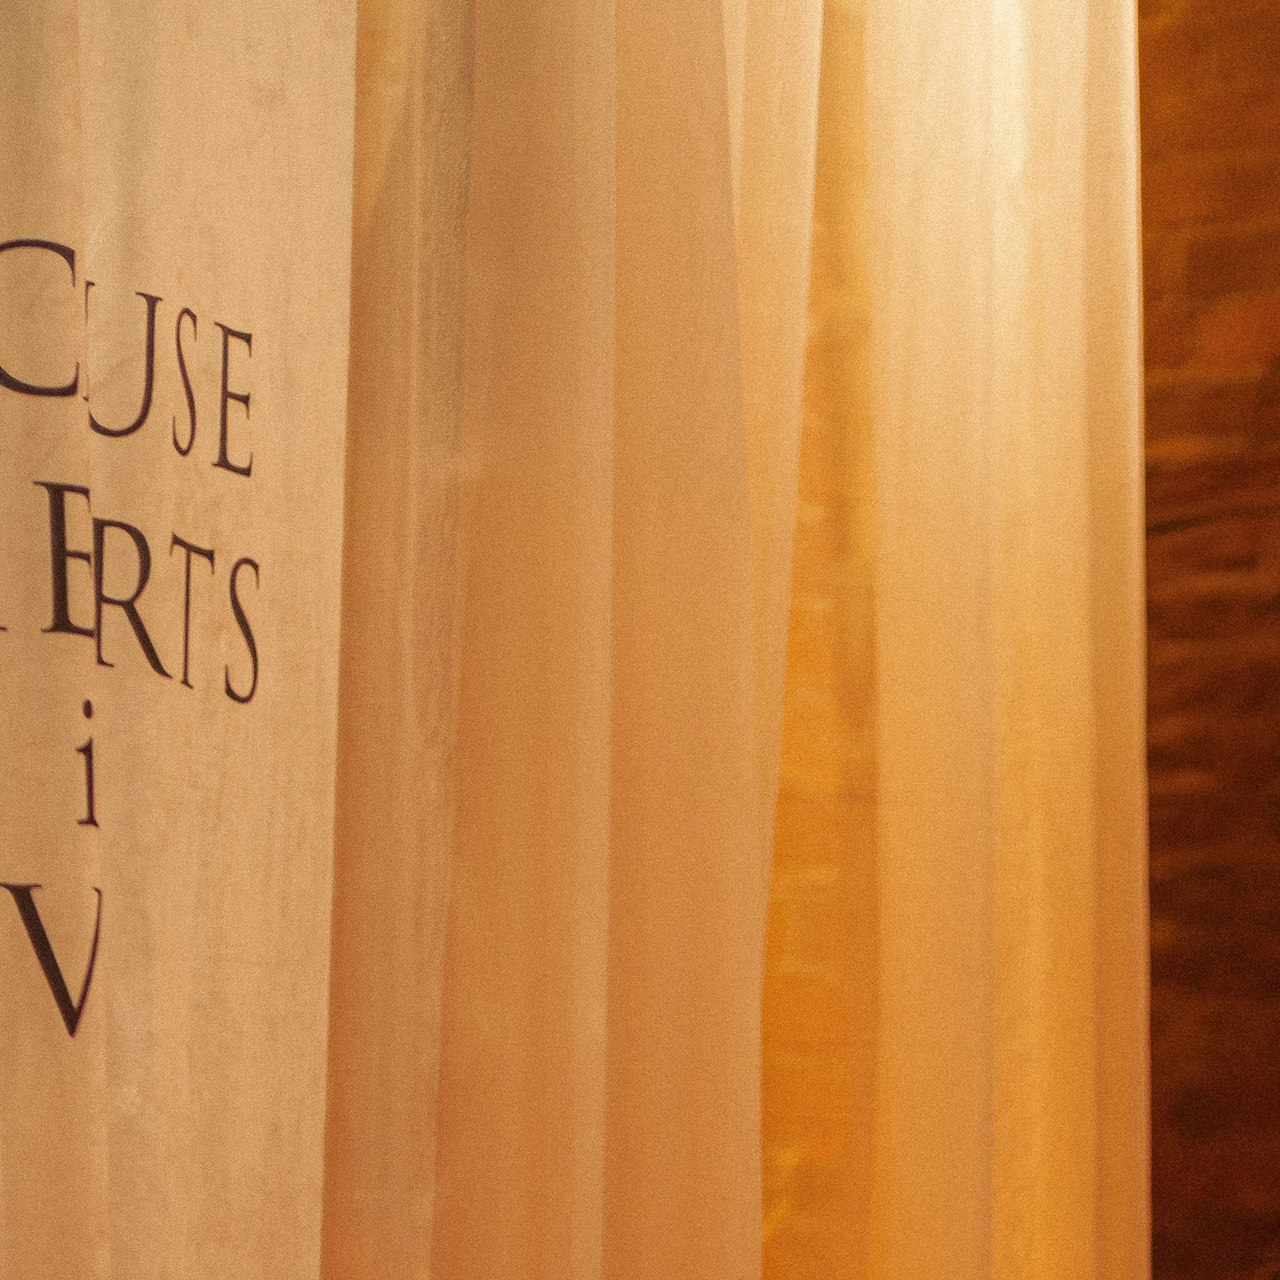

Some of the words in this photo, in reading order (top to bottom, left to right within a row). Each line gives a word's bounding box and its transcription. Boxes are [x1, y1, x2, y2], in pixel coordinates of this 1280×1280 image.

[0, 480, 260, 704] ERTS
[75, 699, 99, 828] i
[0, 882, 103, 1038] V
